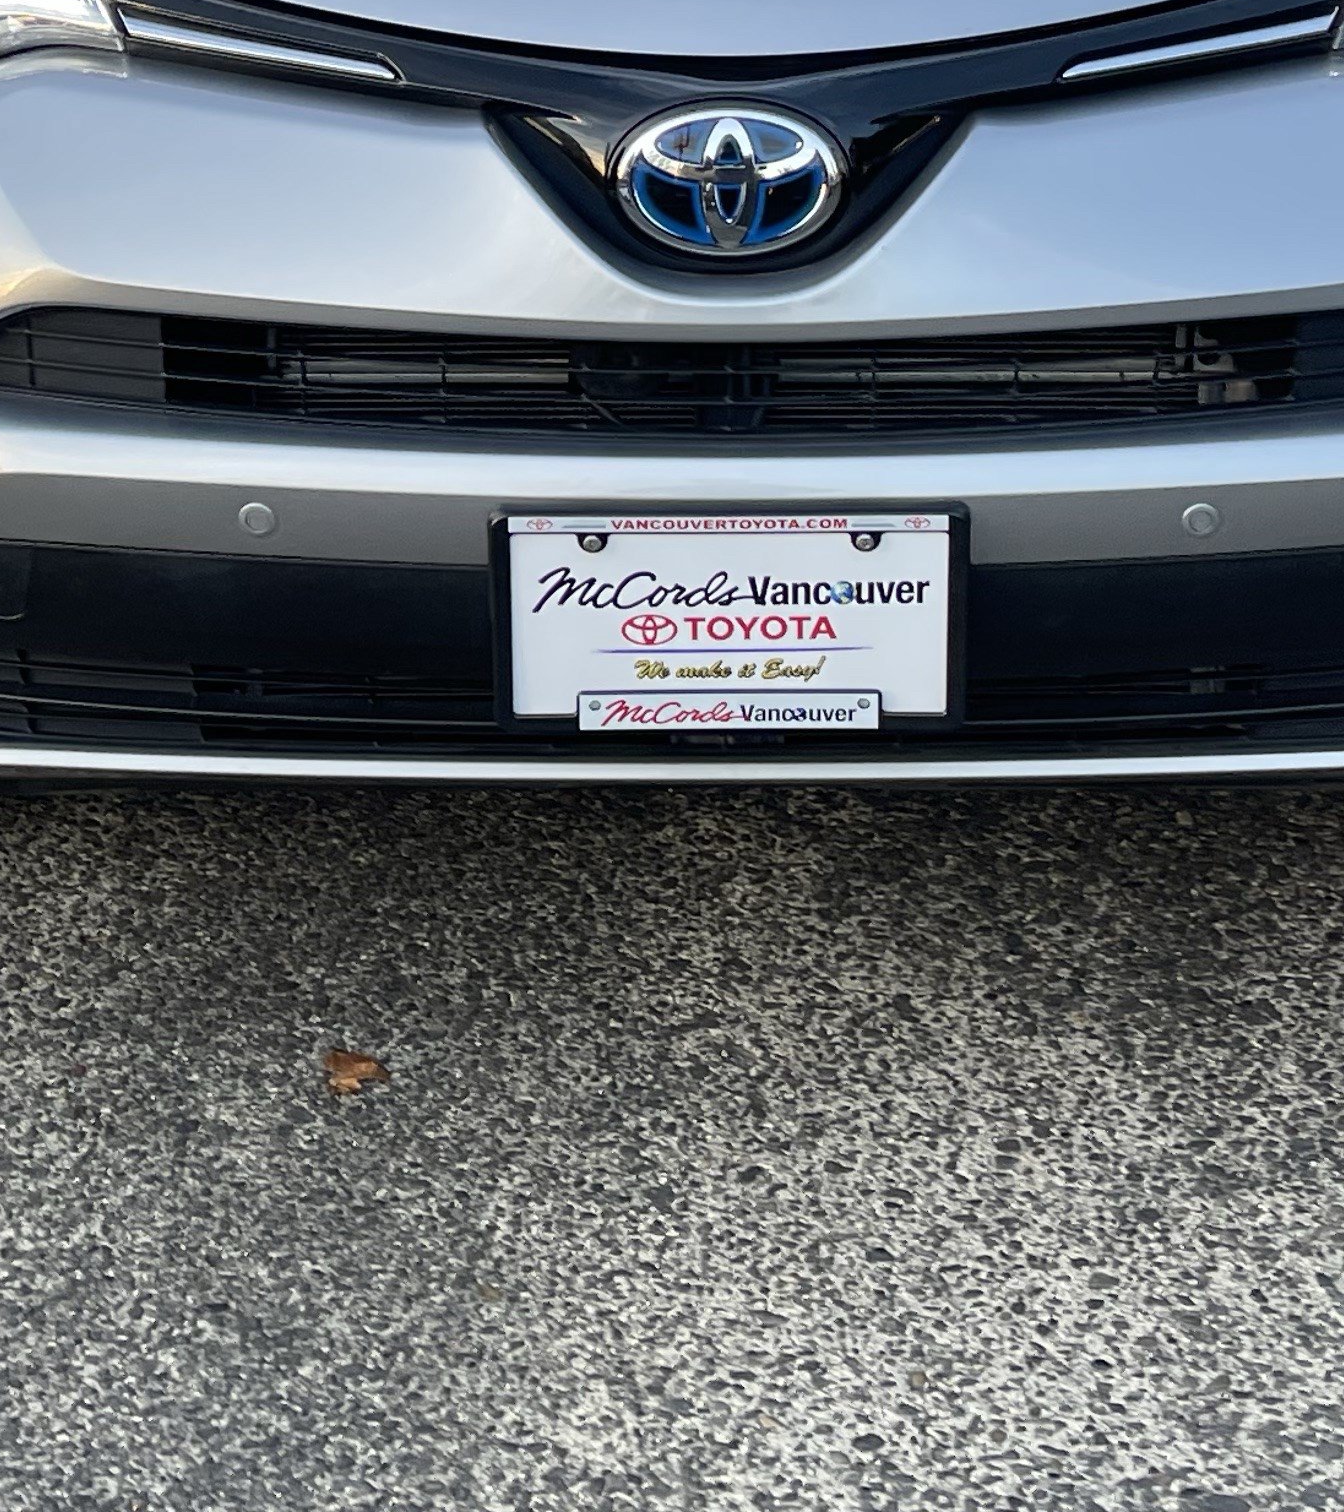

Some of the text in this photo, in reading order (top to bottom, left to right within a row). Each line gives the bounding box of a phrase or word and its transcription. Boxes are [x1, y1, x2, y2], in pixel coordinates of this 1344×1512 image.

[610, 518, 848, 530] VANCOUVERTOYOTA.COM
[683, 615, 838, 641] TOYOTA
[634, 655, 827, 682] We make it Easy!
